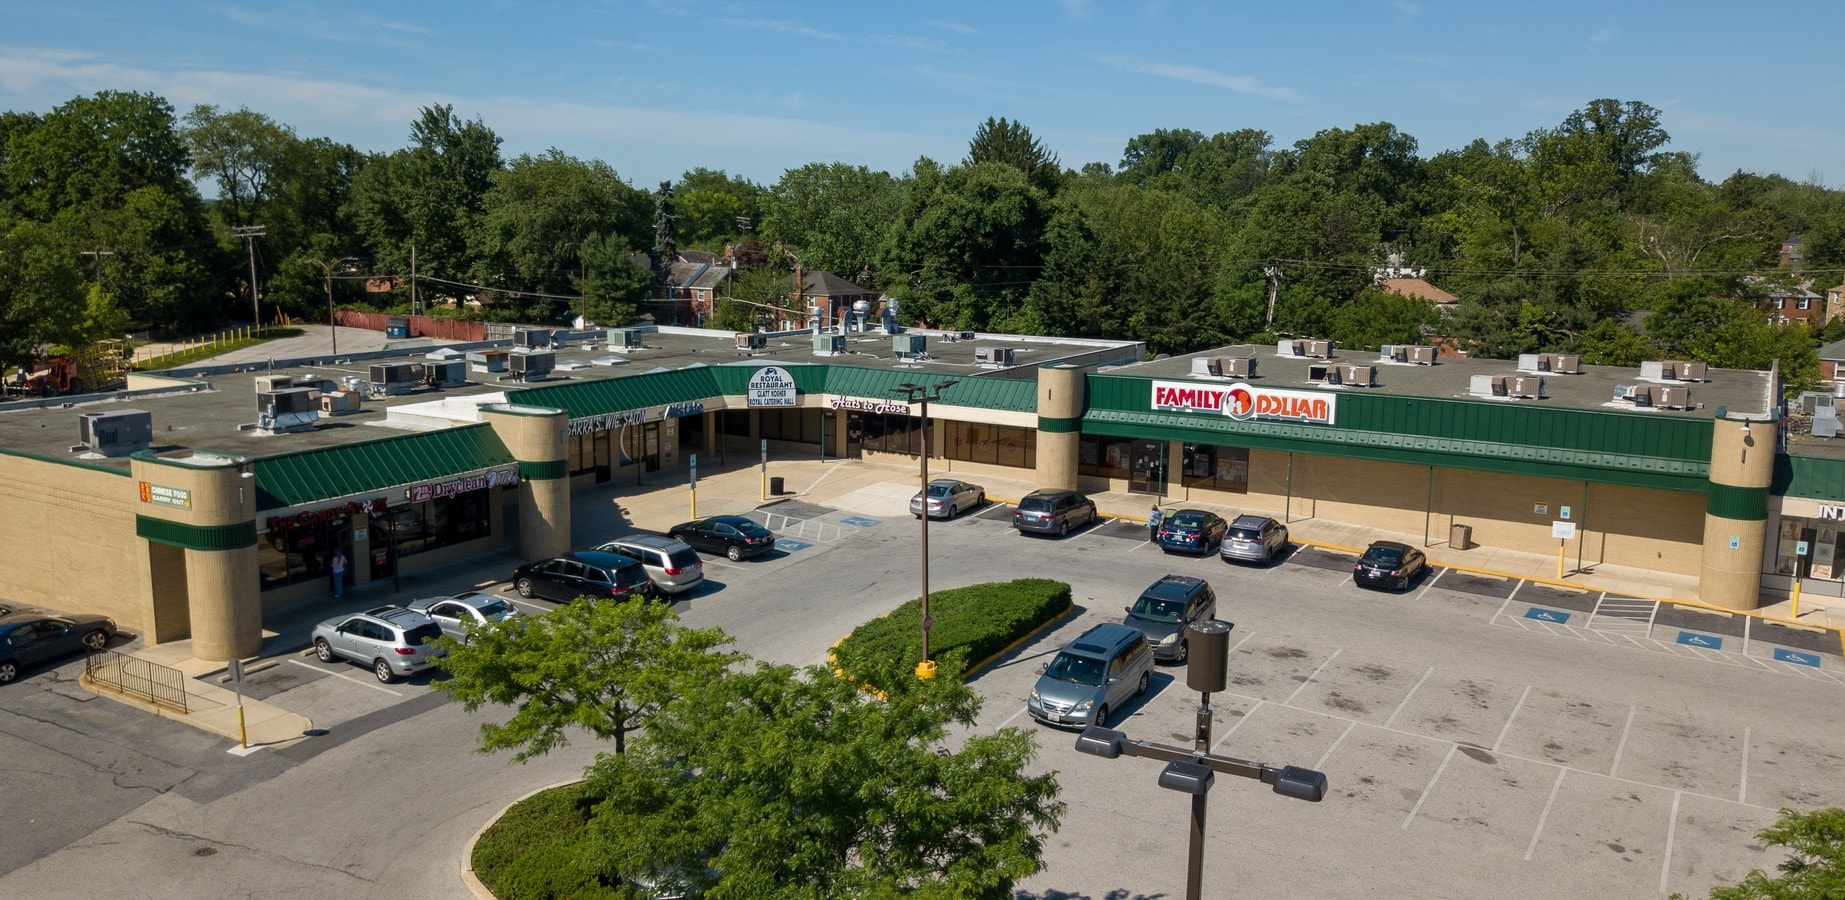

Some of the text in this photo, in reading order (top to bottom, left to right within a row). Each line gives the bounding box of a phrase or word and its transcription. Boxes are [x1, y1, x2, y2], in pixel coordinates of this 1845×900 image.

[750, 381, 793, 389] RESTAURANT
[749, 397, 795, 406] ROYAL CATERING HALL
[757, 390, 787, 398] GLATT KOSHER
[831, 396, 907, 414] Hats to Hose
[1156, 386, 1328, 420] FAMILY DOLLAR
[605, 414, 620, 430] WIG
[623, 410, 646, 426] SALON
[152, 485, 173, 497] CHINESE
[173, 489, 188, 500] FOOD
[433, 476, 487, 499] Dryclean
[152, 494, 185, 506] CARRY OUT
